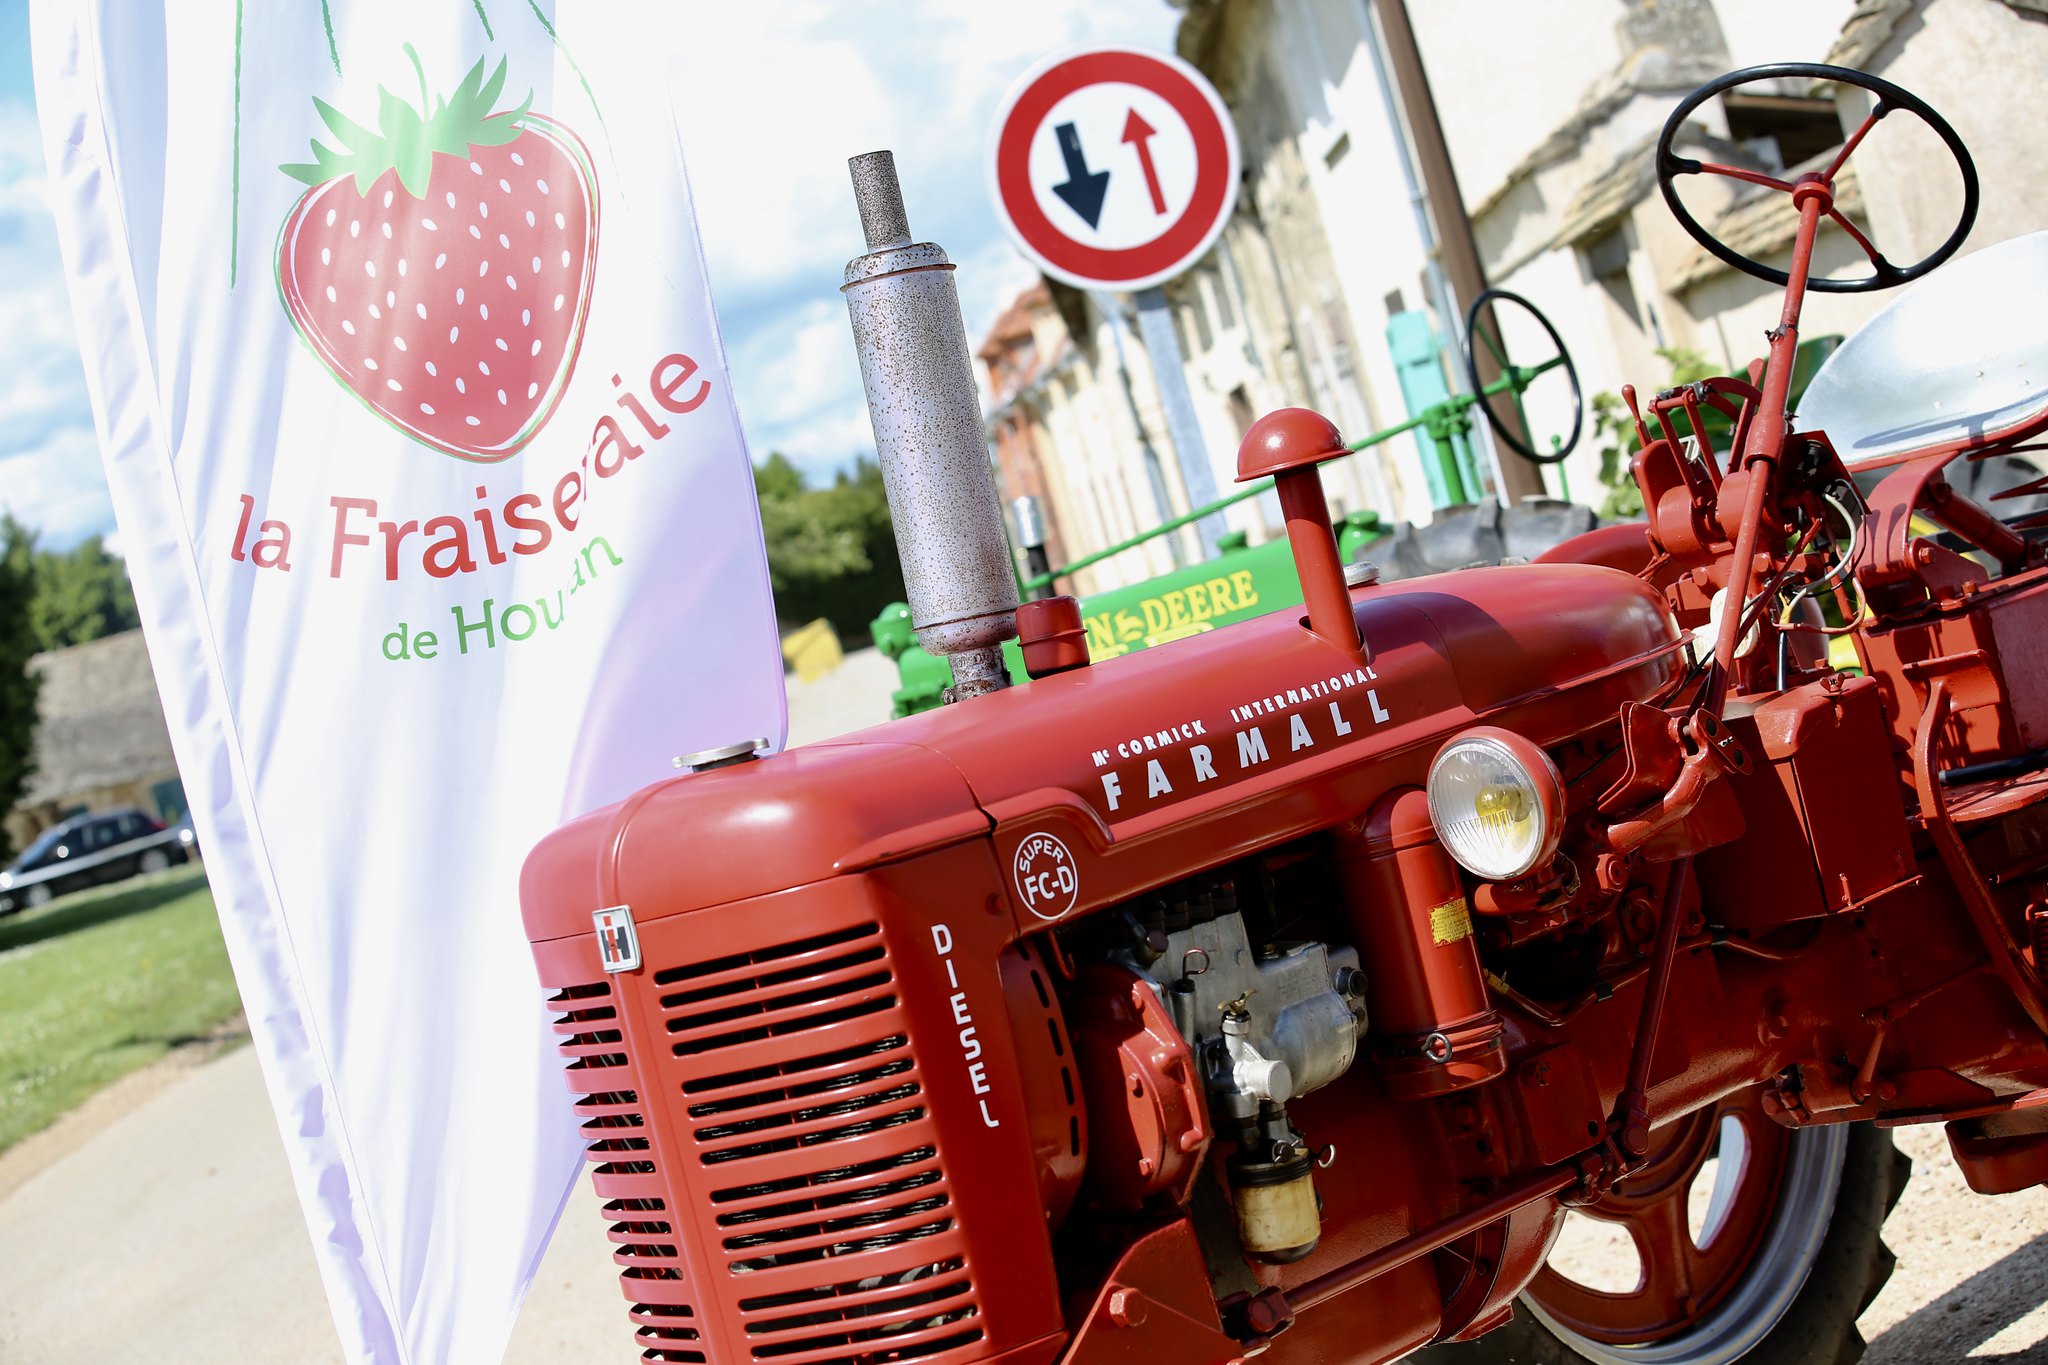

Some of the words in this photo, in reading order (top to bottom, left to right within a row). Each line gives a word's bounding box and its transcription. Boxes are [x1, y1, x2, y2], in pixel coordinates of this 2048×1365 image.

[230, 493, 293, 573] la
[1139, 569, 1259, 637] DEERE
[382, 622, 438, 661] de
[1117, 719, 1207, 759] CORMICK
[1229, 666, 1378, 724] INTERNATIONAL
[1100, 689, 1390, 811] FARMALL
[1019, 839, 1064, 874] SUPER
[1024, 865, 1075, 905] FC-D
[930, 923, 1000, 1128] DIESEL
